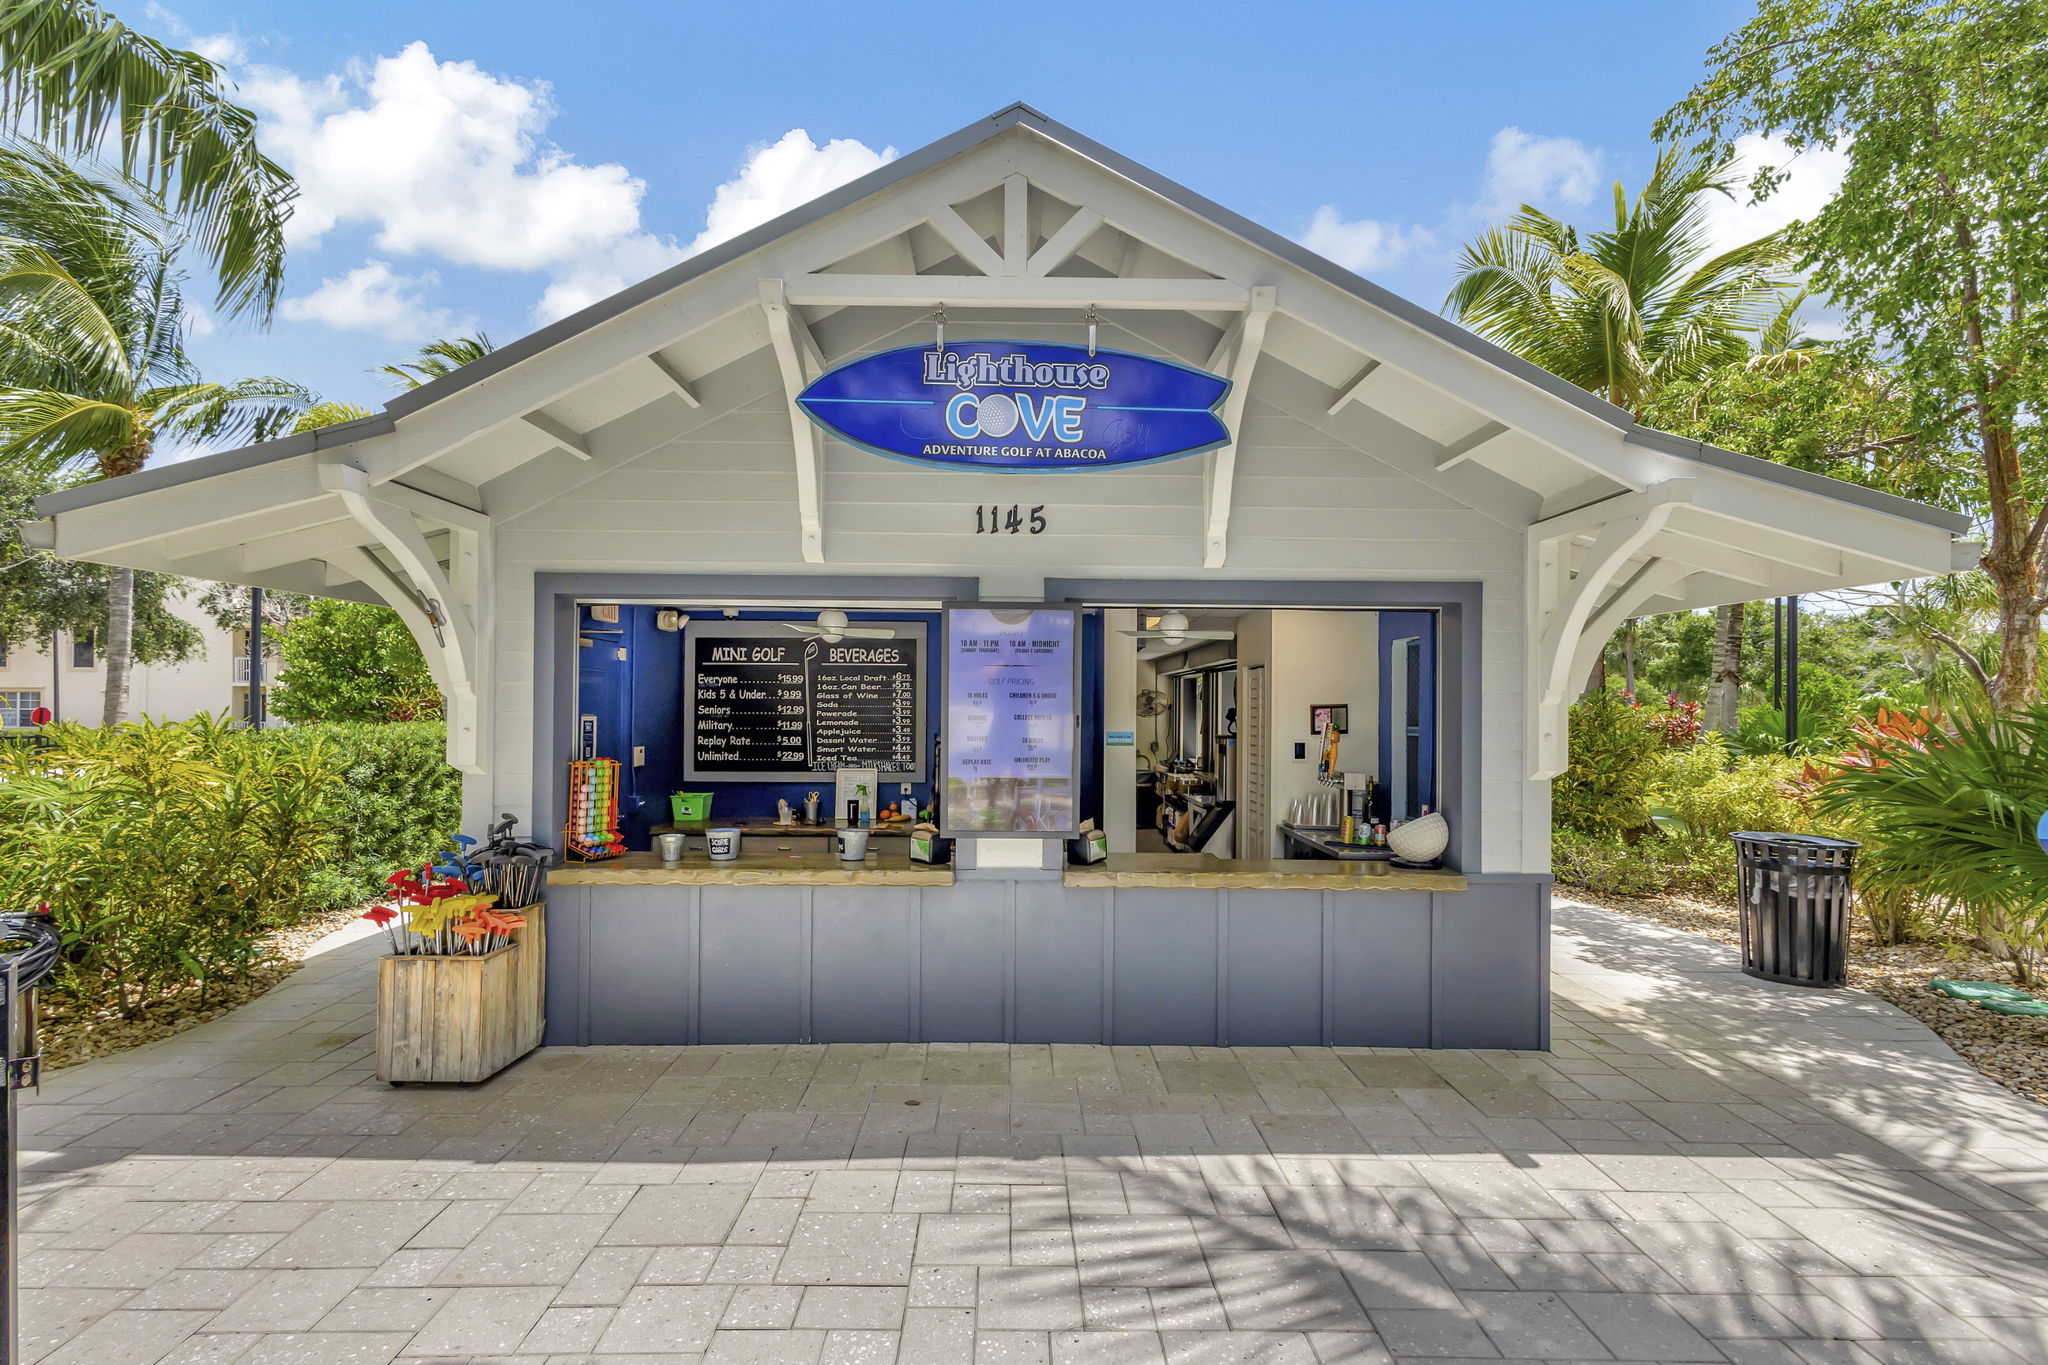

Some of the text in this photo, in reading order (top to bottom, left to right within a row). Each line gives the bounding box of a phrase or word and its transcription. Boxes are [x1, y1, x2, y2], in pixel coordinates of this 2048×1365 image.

[924, 352, 1110, 390] Lighthouse
[946, 392, 1086, 442] COVE
[922, 445, 1106, 460] ADVENTURE GOLF AT ABACOA
[976, 504, 1046, 534] 1145
[712, 647, 786, 662] MINI GOLF
[830, 648, 900, 662] BEVERAGES
[698, 674, 738, 686] Everyone
[698, 690, 766, 699] Kids 5 & Under
[698, 705, 730, 714] Seniors
[698, 720, 732, 732] Military
[698, 735, 750, 748] Replay Rate
[698, 751, 740, 760] Unlimited
